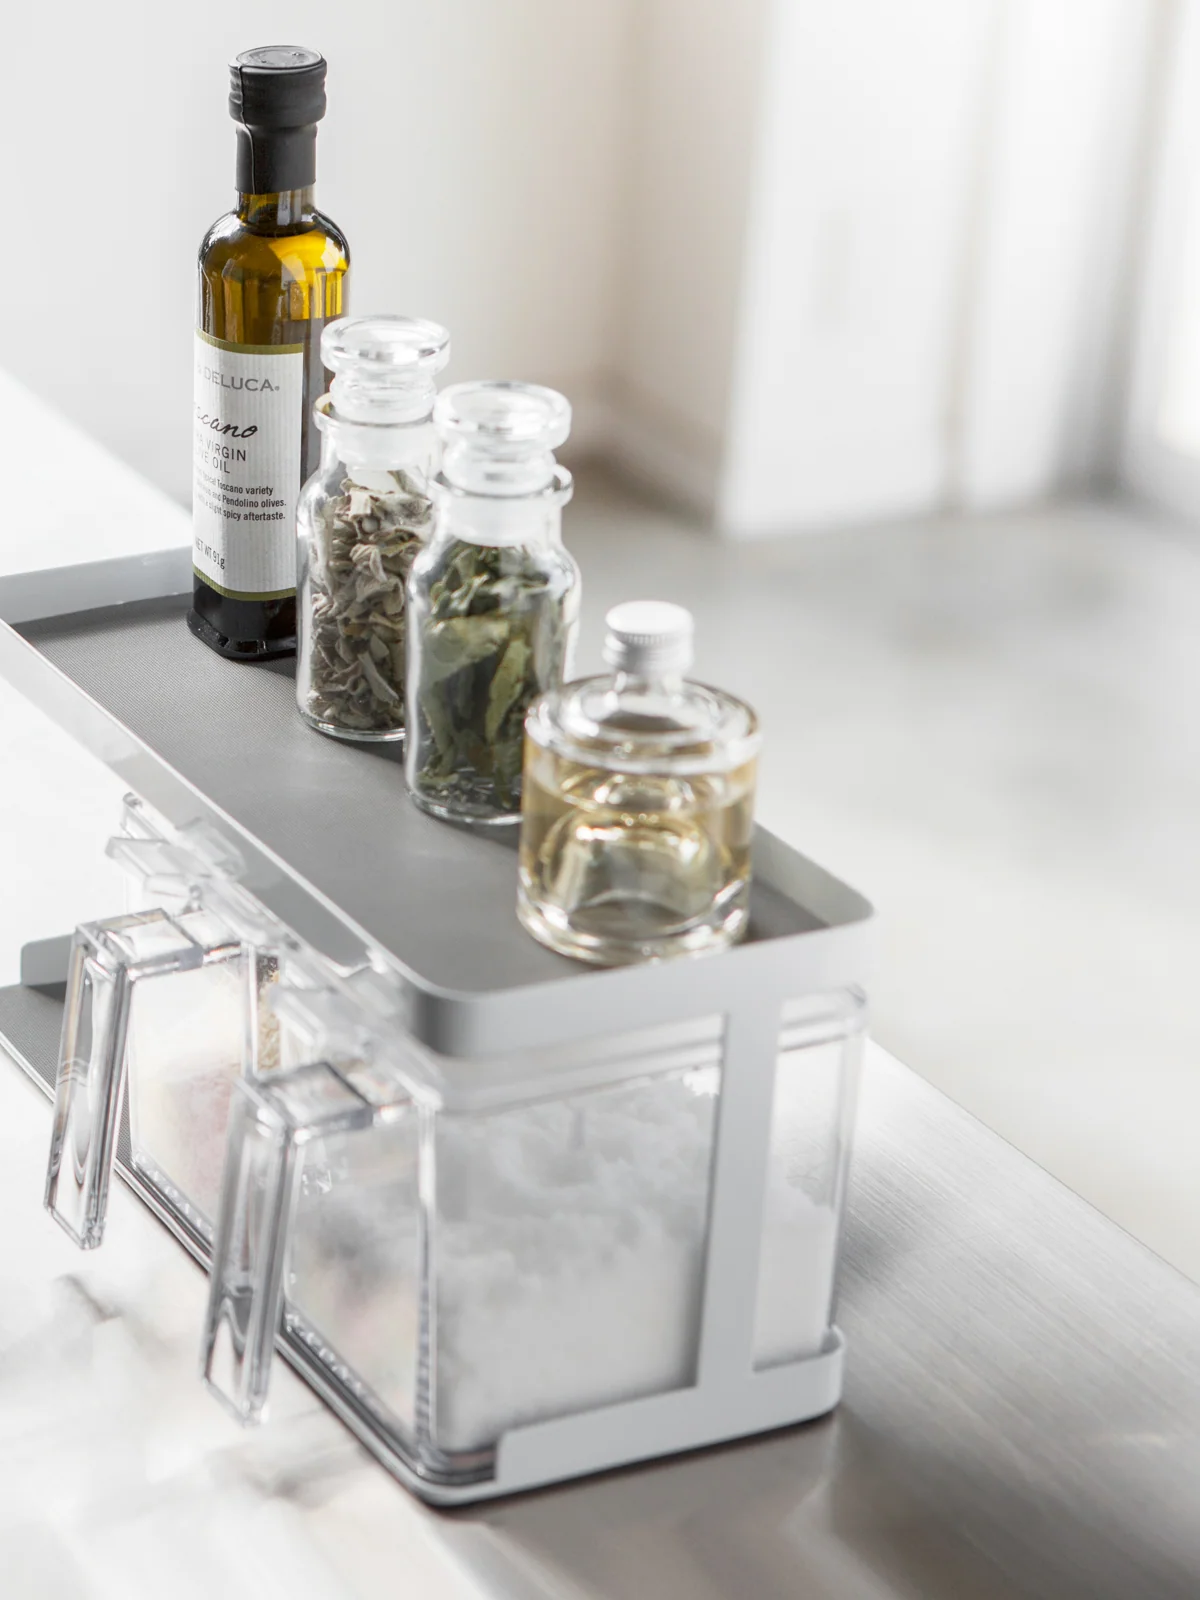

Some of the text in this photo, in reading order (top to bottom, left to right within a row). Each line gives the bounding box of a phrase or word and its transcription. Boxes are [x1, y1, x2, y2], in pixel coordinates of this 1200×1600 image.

[207, 439, 246, 462] VIRGIN
[212, 456, 231, 474] OIL
[217, 479, 243, 494] Toscano
[246, 486, 274, 497] variety
[222, 495, 259, 508] Pendolino
[261, 499, 287, 508] olives.
[223, 509, 241, 522] spicy
[243, 511, 286, 521] aftertaste.
